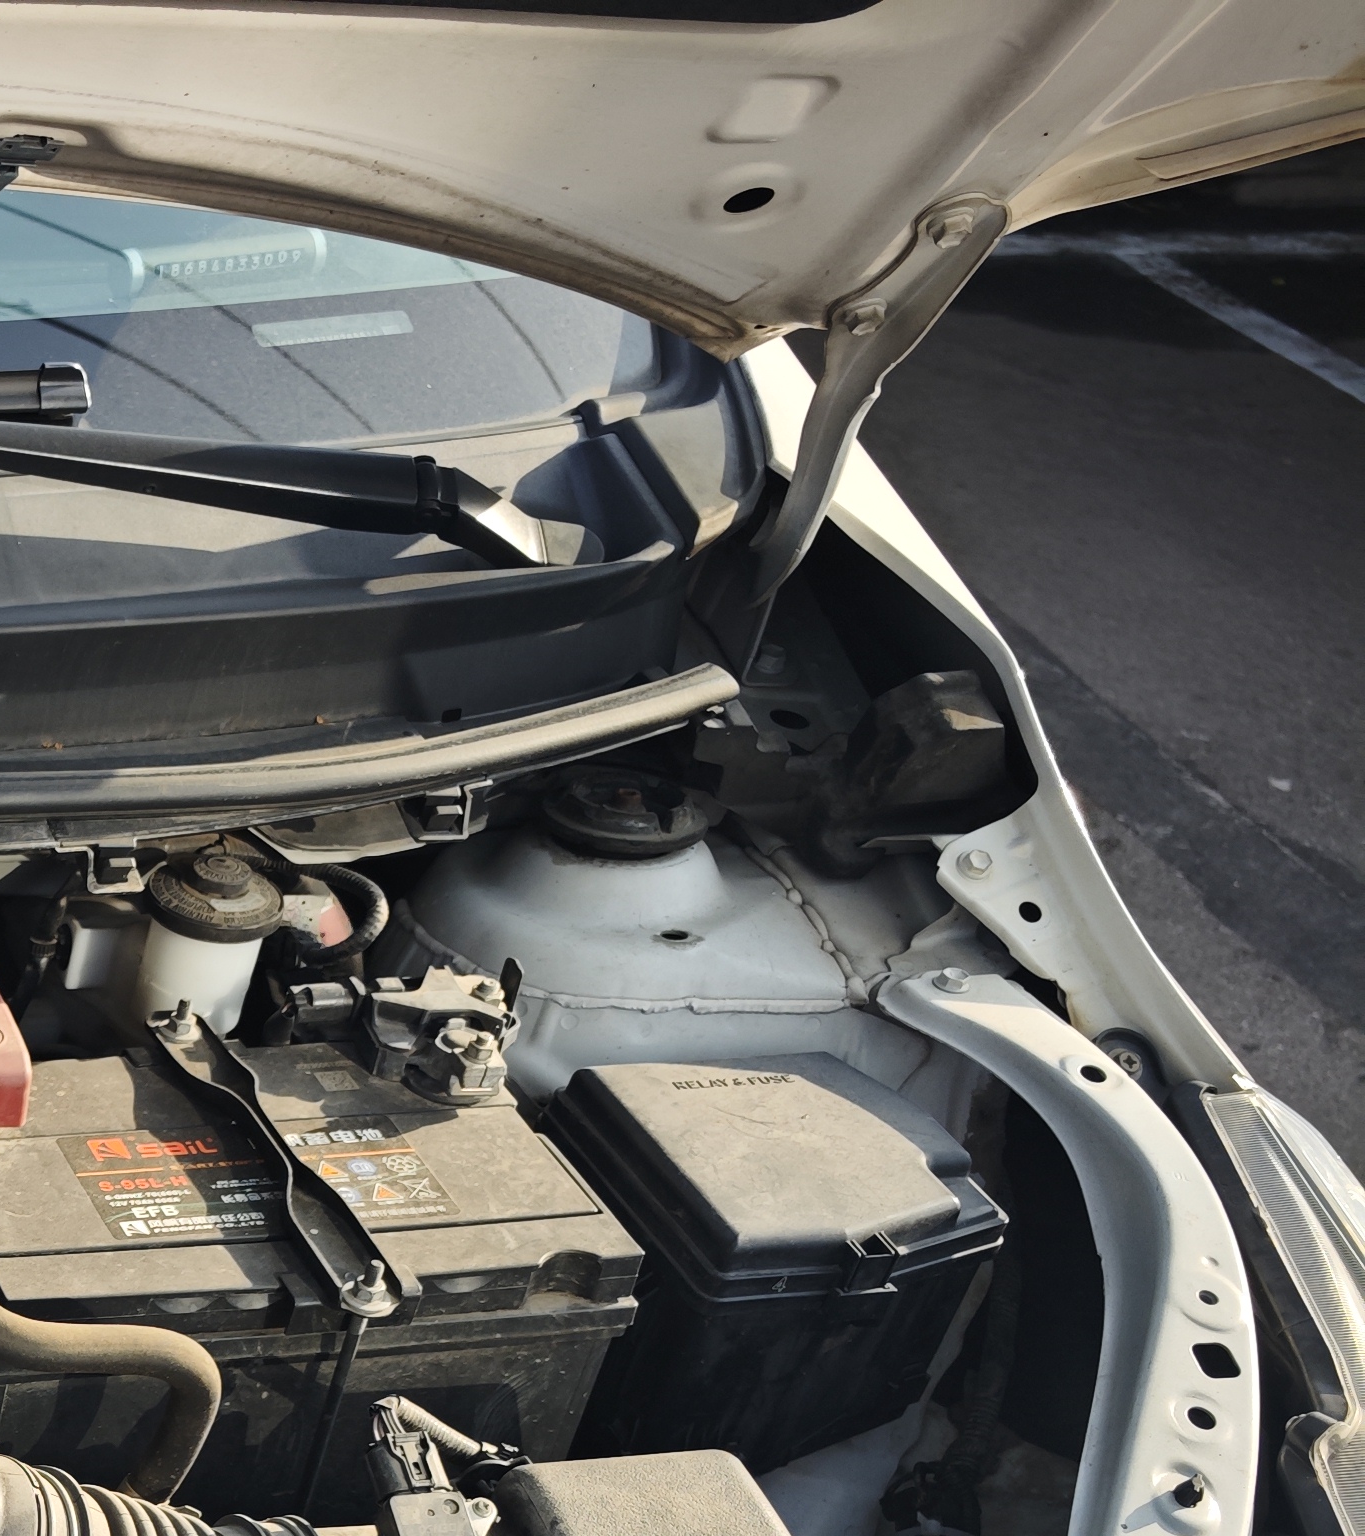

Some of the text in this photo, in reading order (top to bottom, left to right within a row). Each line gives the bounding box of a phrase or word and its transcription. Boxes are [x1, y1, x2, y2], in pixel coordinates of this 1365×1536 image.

[158, 249, 302, 279] 18684833009
[672, 1073, 796, 1092] RELAY & FUSE
[131, 1205, 180, 1219] EFB
